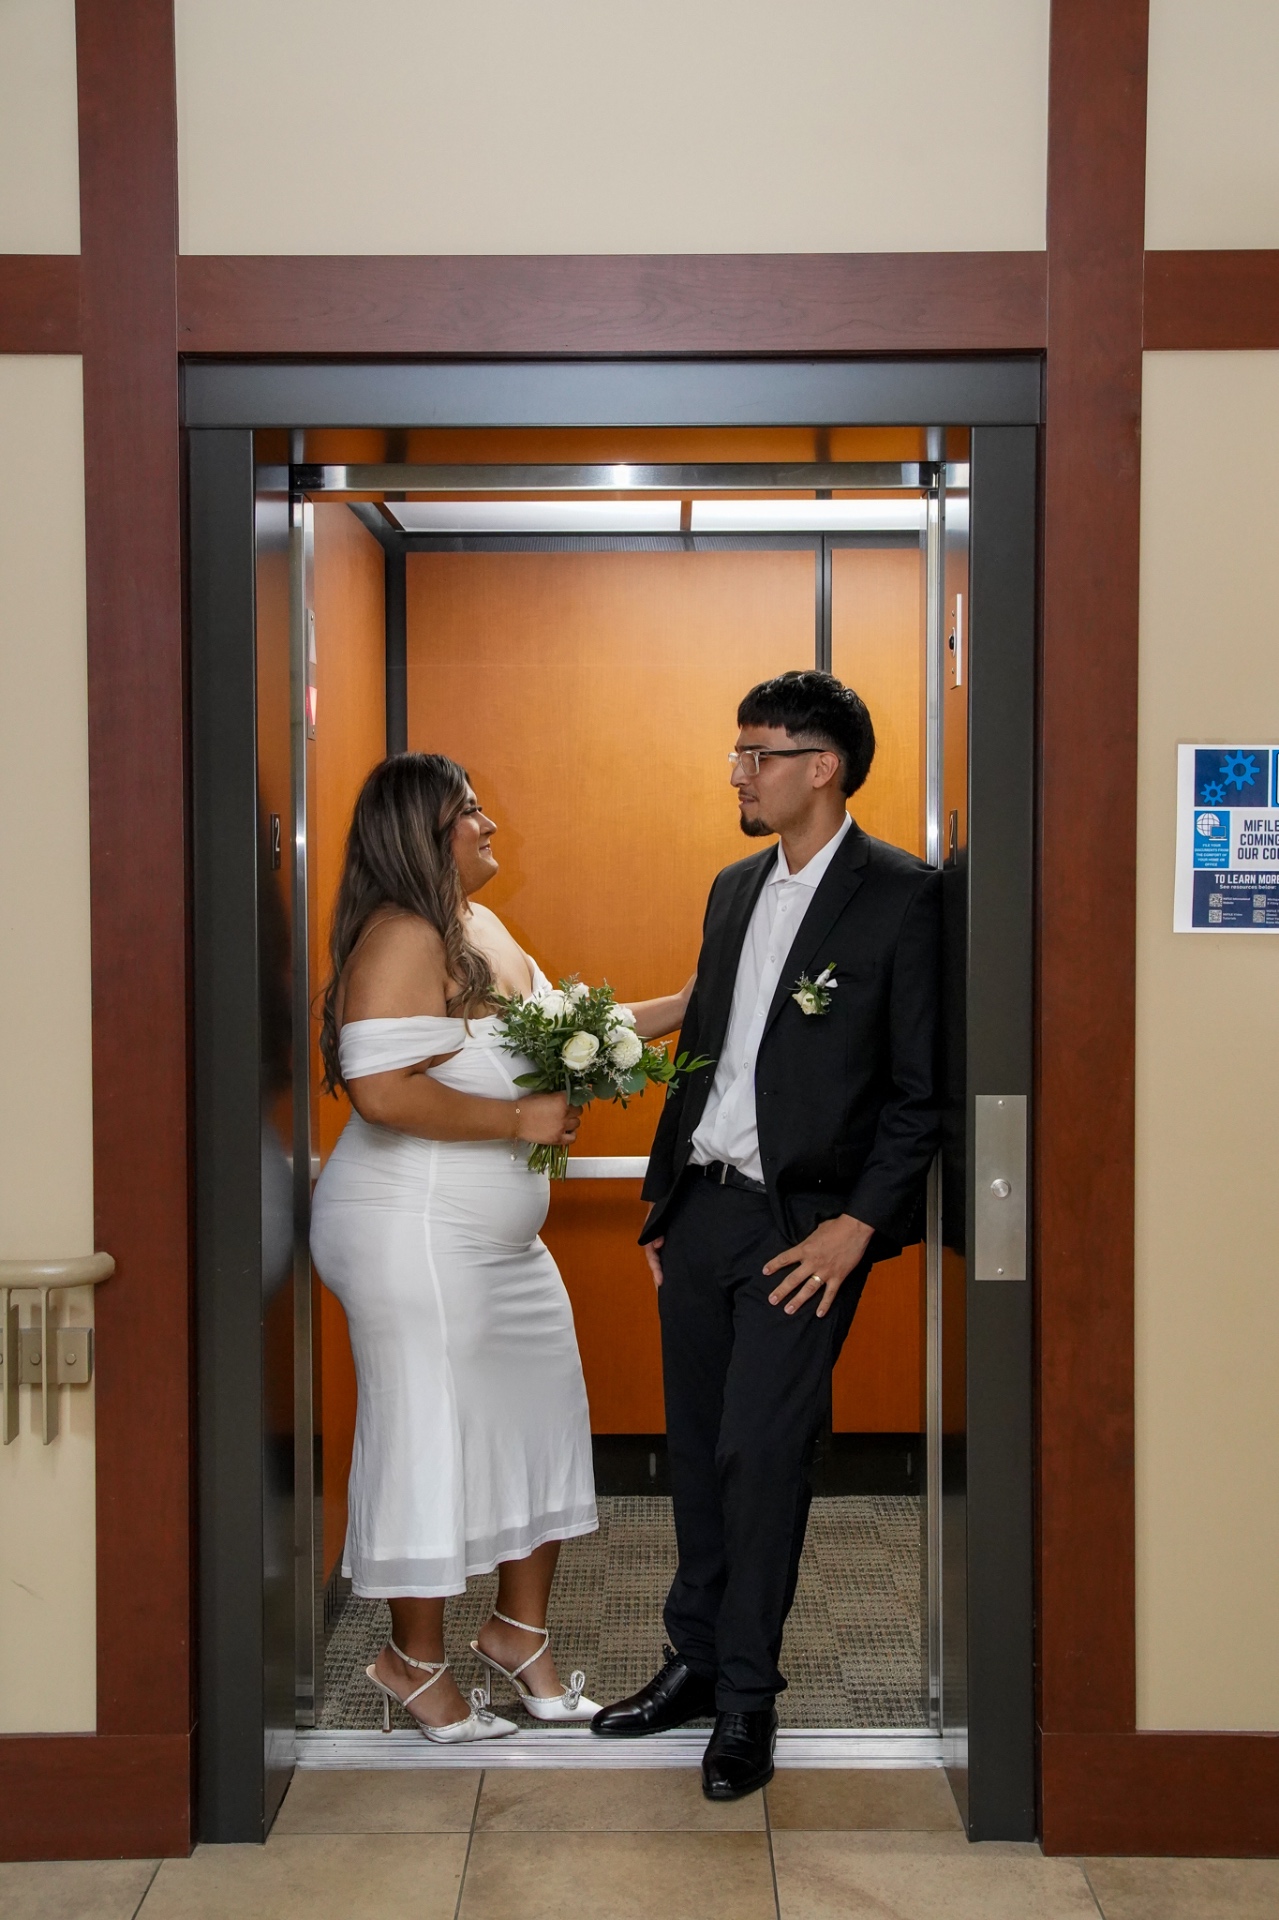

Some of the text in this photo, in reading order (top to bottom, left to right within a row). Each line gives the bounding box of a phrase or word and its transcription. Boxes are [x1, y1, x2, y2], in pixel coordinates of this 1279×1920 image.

[950, 814, 954, 849] 2
[1244, 819, 1279, 832] MIFILE
[275, 818, 280, 852] 2
[1240, 833, 1279, 846] COMING
[1237, 847, 1259, 860] OUR
[1214, 874, 1226, 884] TO
[1227, 874, 1257, 884] LEARN
